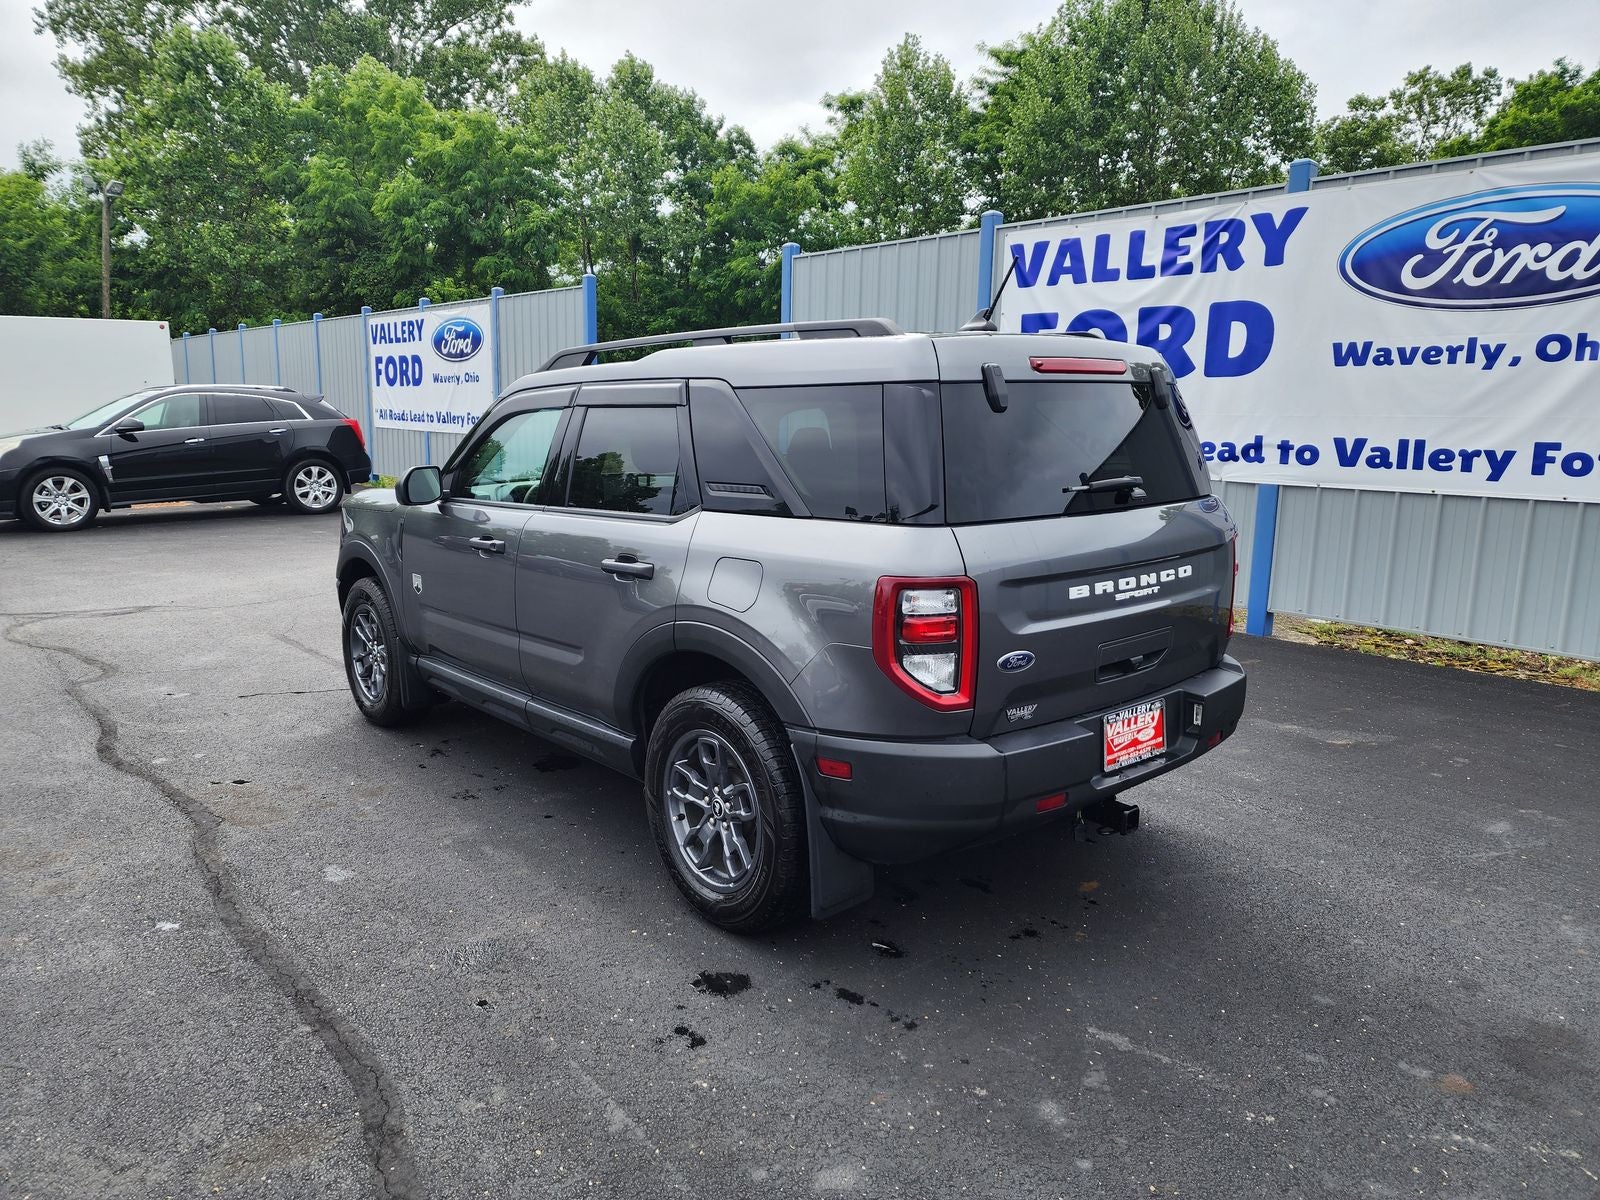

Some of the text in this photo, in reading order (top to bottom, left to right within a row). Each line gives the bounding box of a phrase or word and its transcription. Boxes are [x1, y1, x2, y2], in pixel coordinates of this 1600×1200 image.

[1010, 206, 1309, 288] VALLERY
[370, 319, 425, 345] VALLERY
[441, 325, 473, 355] Ford
[1021, 300, 1275, 379] RD
[1332, 332, 1600, 371] Waverly, Oh
[375, 355, 423, 387] FORD
[464, 371, 480, 383] Ohio
[389, 408, 409, 422] Roads
[410, 409, 426, 423] Lead
[426, 412, 435, 423] to
[436, 411, 465, 428] Vallery
[1200, 435, 1264, 464] ead
[1277, 439, 1320, 467] to
[1333, 437, 1517, 481] Vallery
[1068, 564, 1193, 600] BRONCO
[1115, 585, 1160, 601] SPORT
[1006, 703, 1038, 717] VALLERY
[1106, 709, 1160, 738] VALLERY
[1119, 703, 1152, 720] VALLERY
